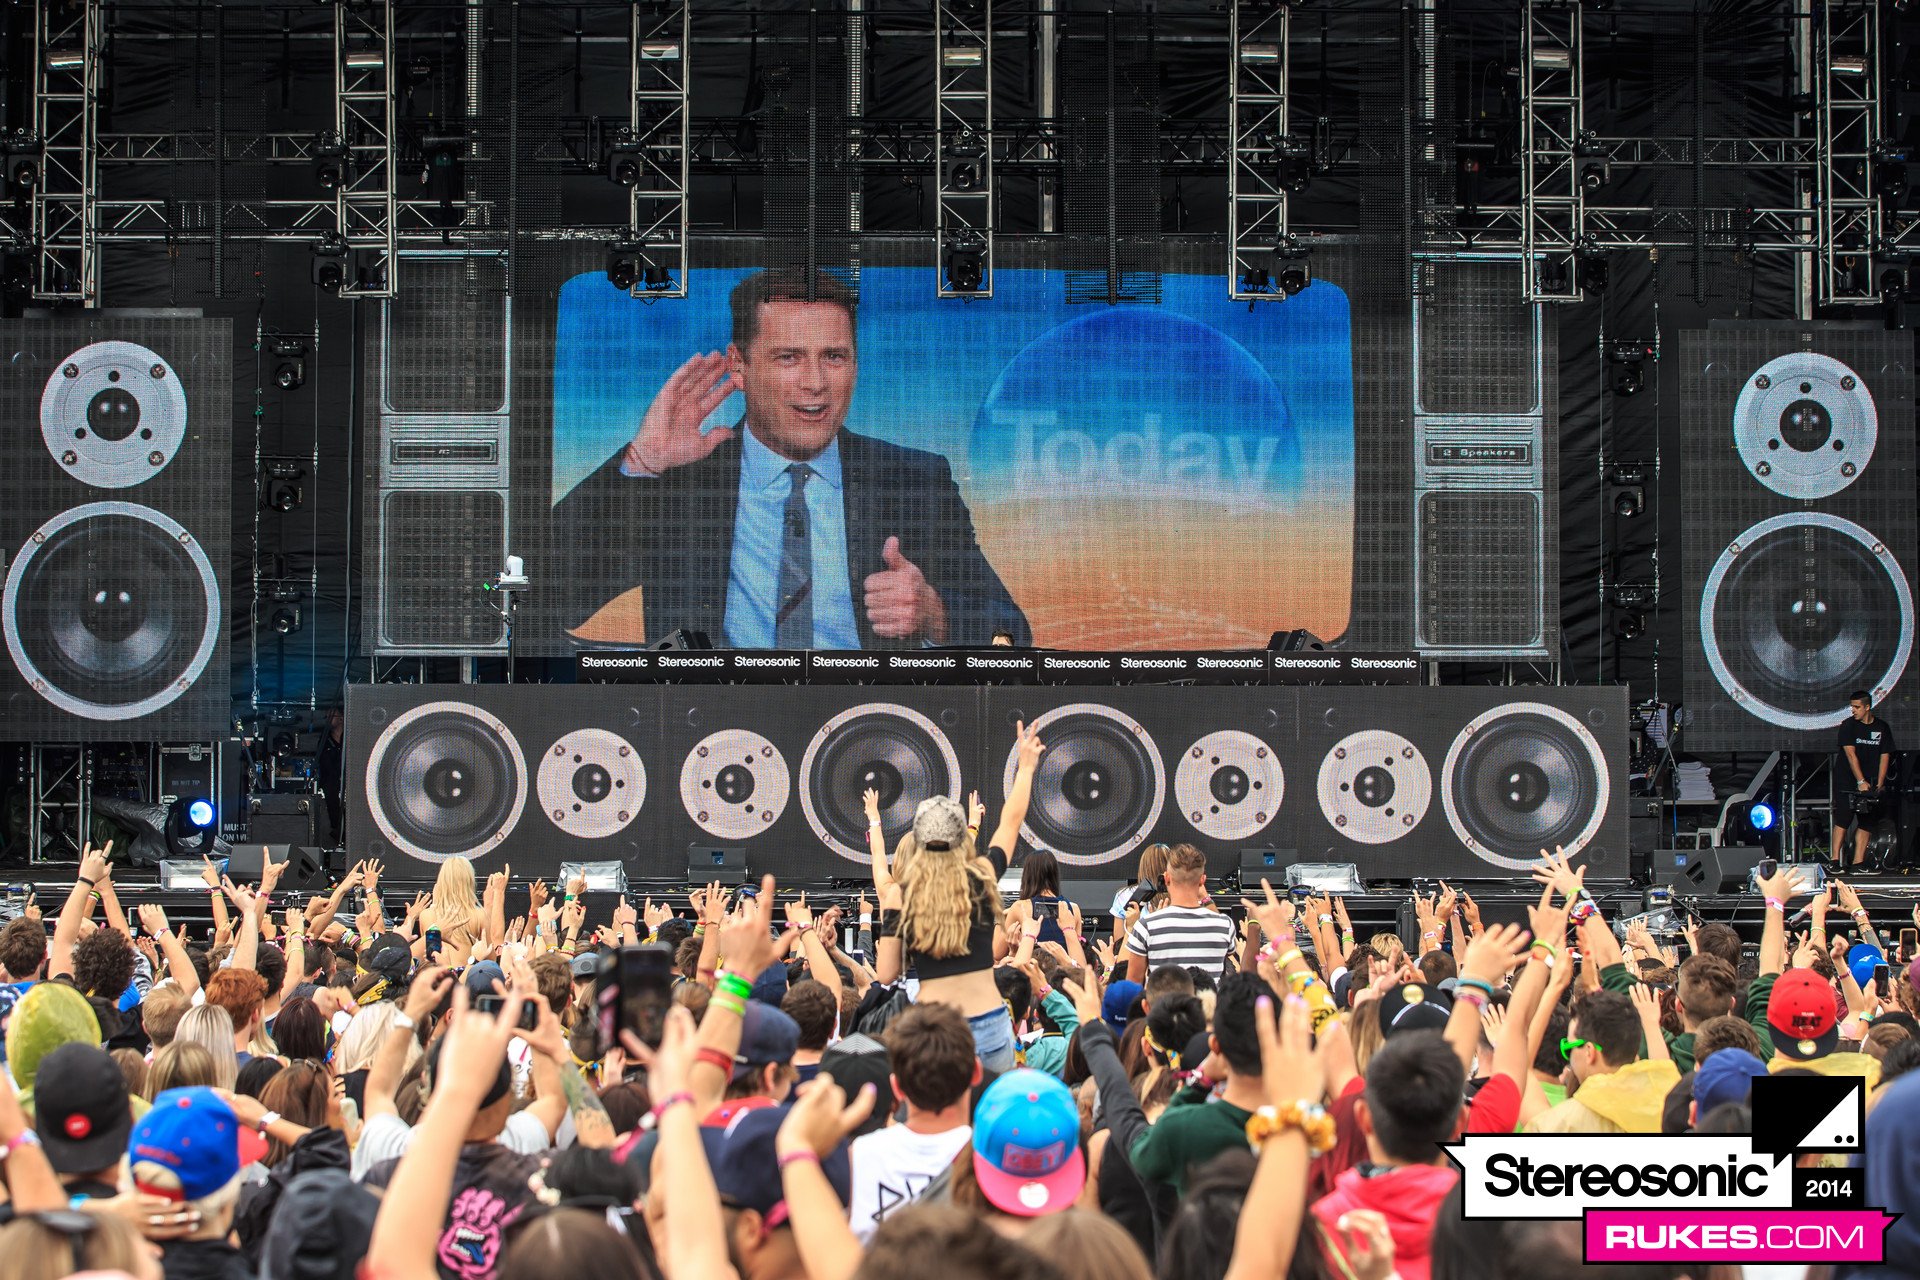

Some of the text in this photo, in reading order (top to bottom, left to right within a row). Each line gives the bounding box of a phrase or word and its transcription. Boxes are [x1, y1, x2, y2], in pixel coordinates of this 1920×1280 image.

[992, 410, 1280, 495] Today
[1460, 448, 1516, 457] Speakers
[582, 656, 1418, 669] Stereosonic Stereosonic Stereosonic Stereosonic Stereosonic Stereosonic Stereosonic Stereosonic Stereosonic Stereosonic Stereosonic
